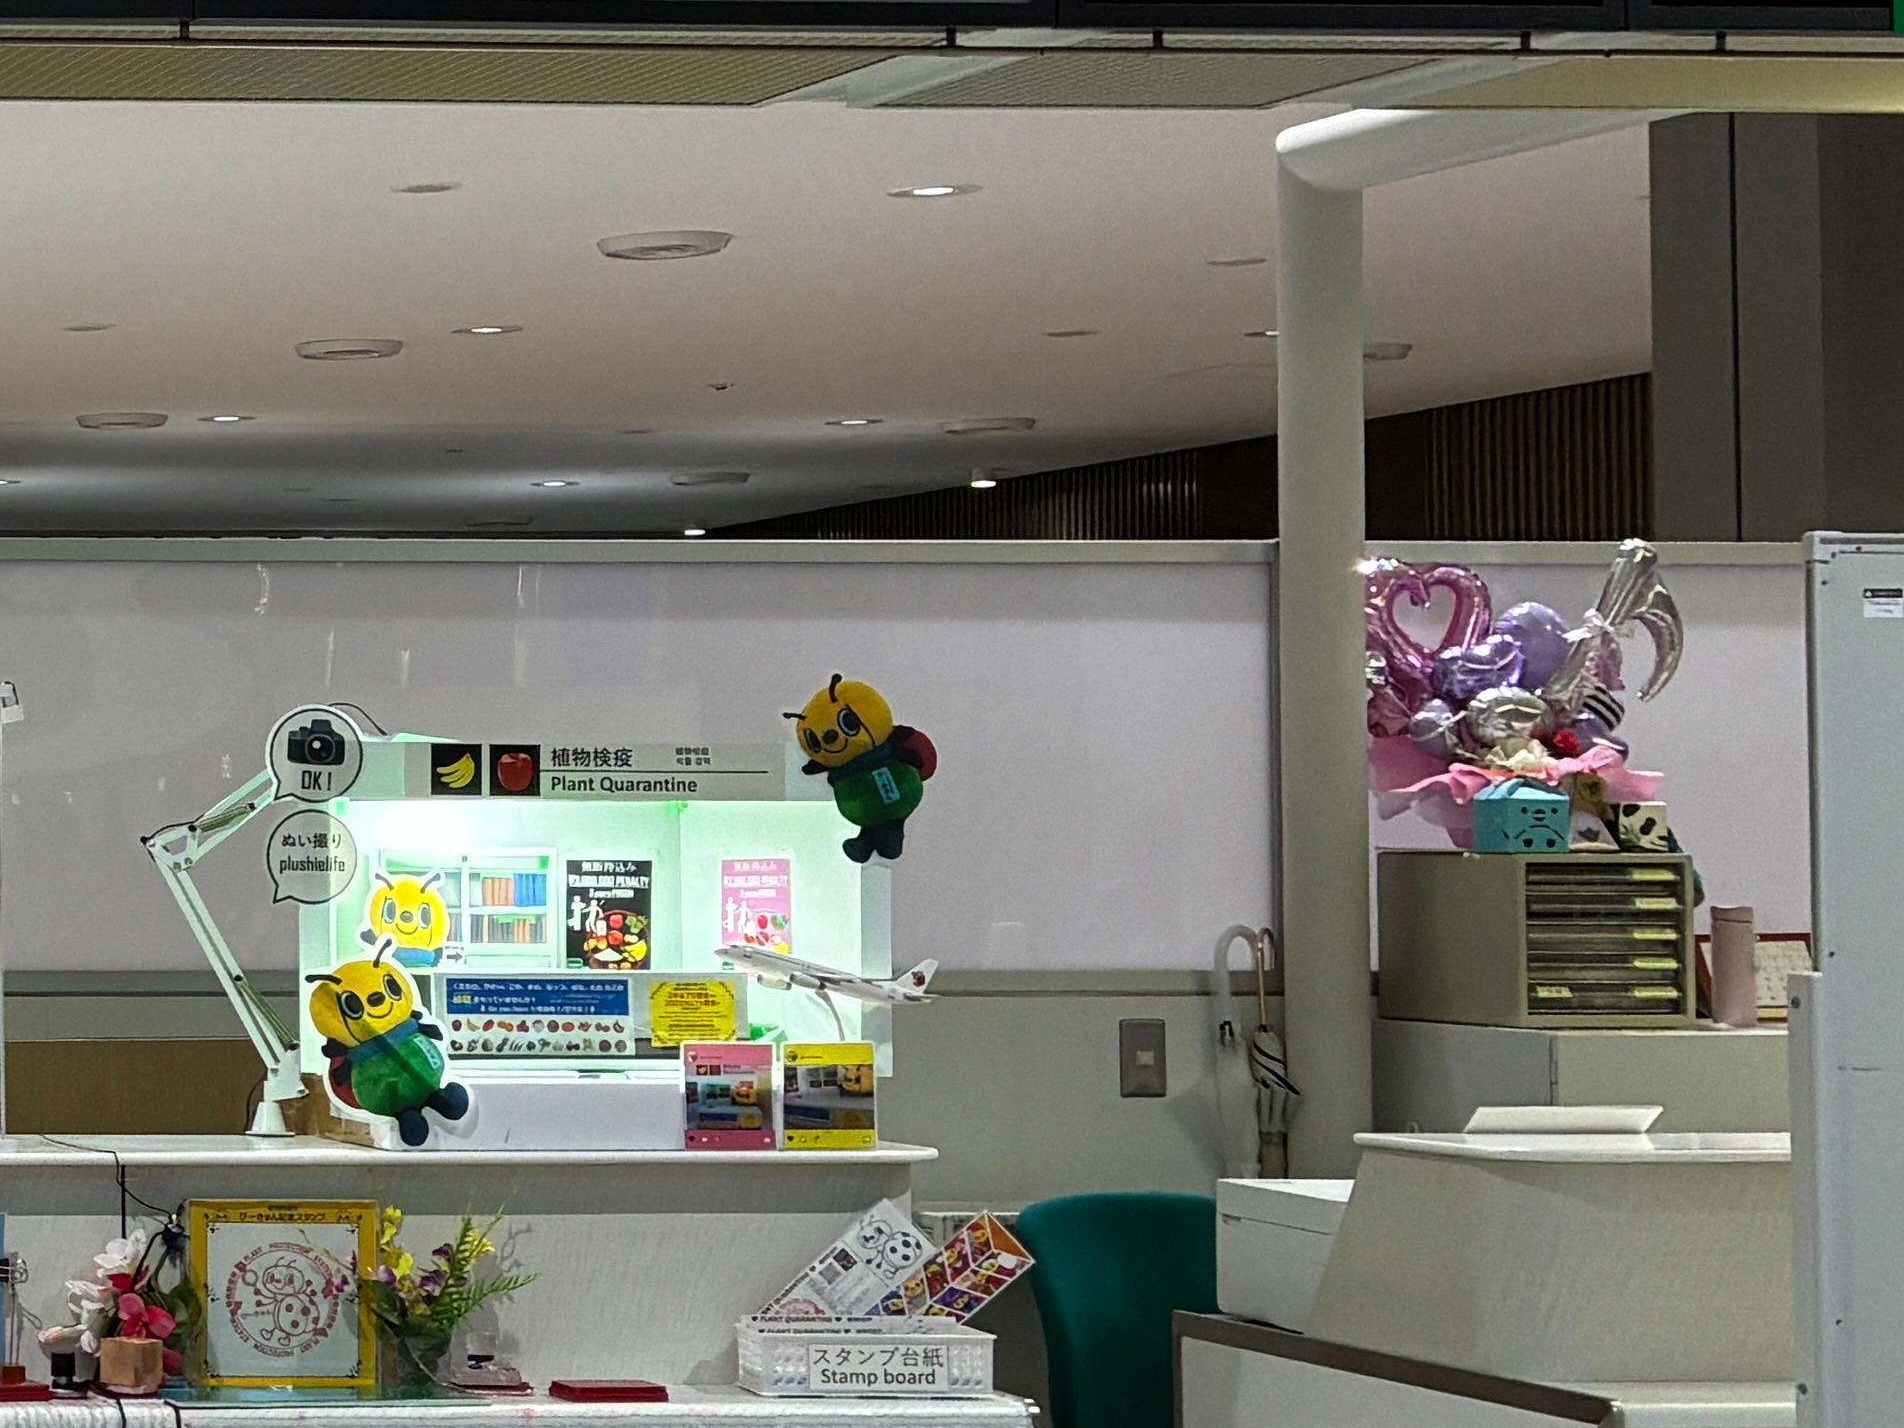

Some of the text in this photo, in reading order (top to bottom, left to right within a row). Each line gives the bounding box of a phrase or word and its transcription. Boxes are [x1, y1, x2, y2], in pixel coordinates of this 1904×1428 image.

[551, 747, 633, 767] 植物検疫
[551, 775, 698, 793] Plant Quarantine
[279, 855, 345, 874] plushielife
[813, 1347, 944, 1368] スタンプ台紙
[821, 1368, 936, 1387] Stamp board
